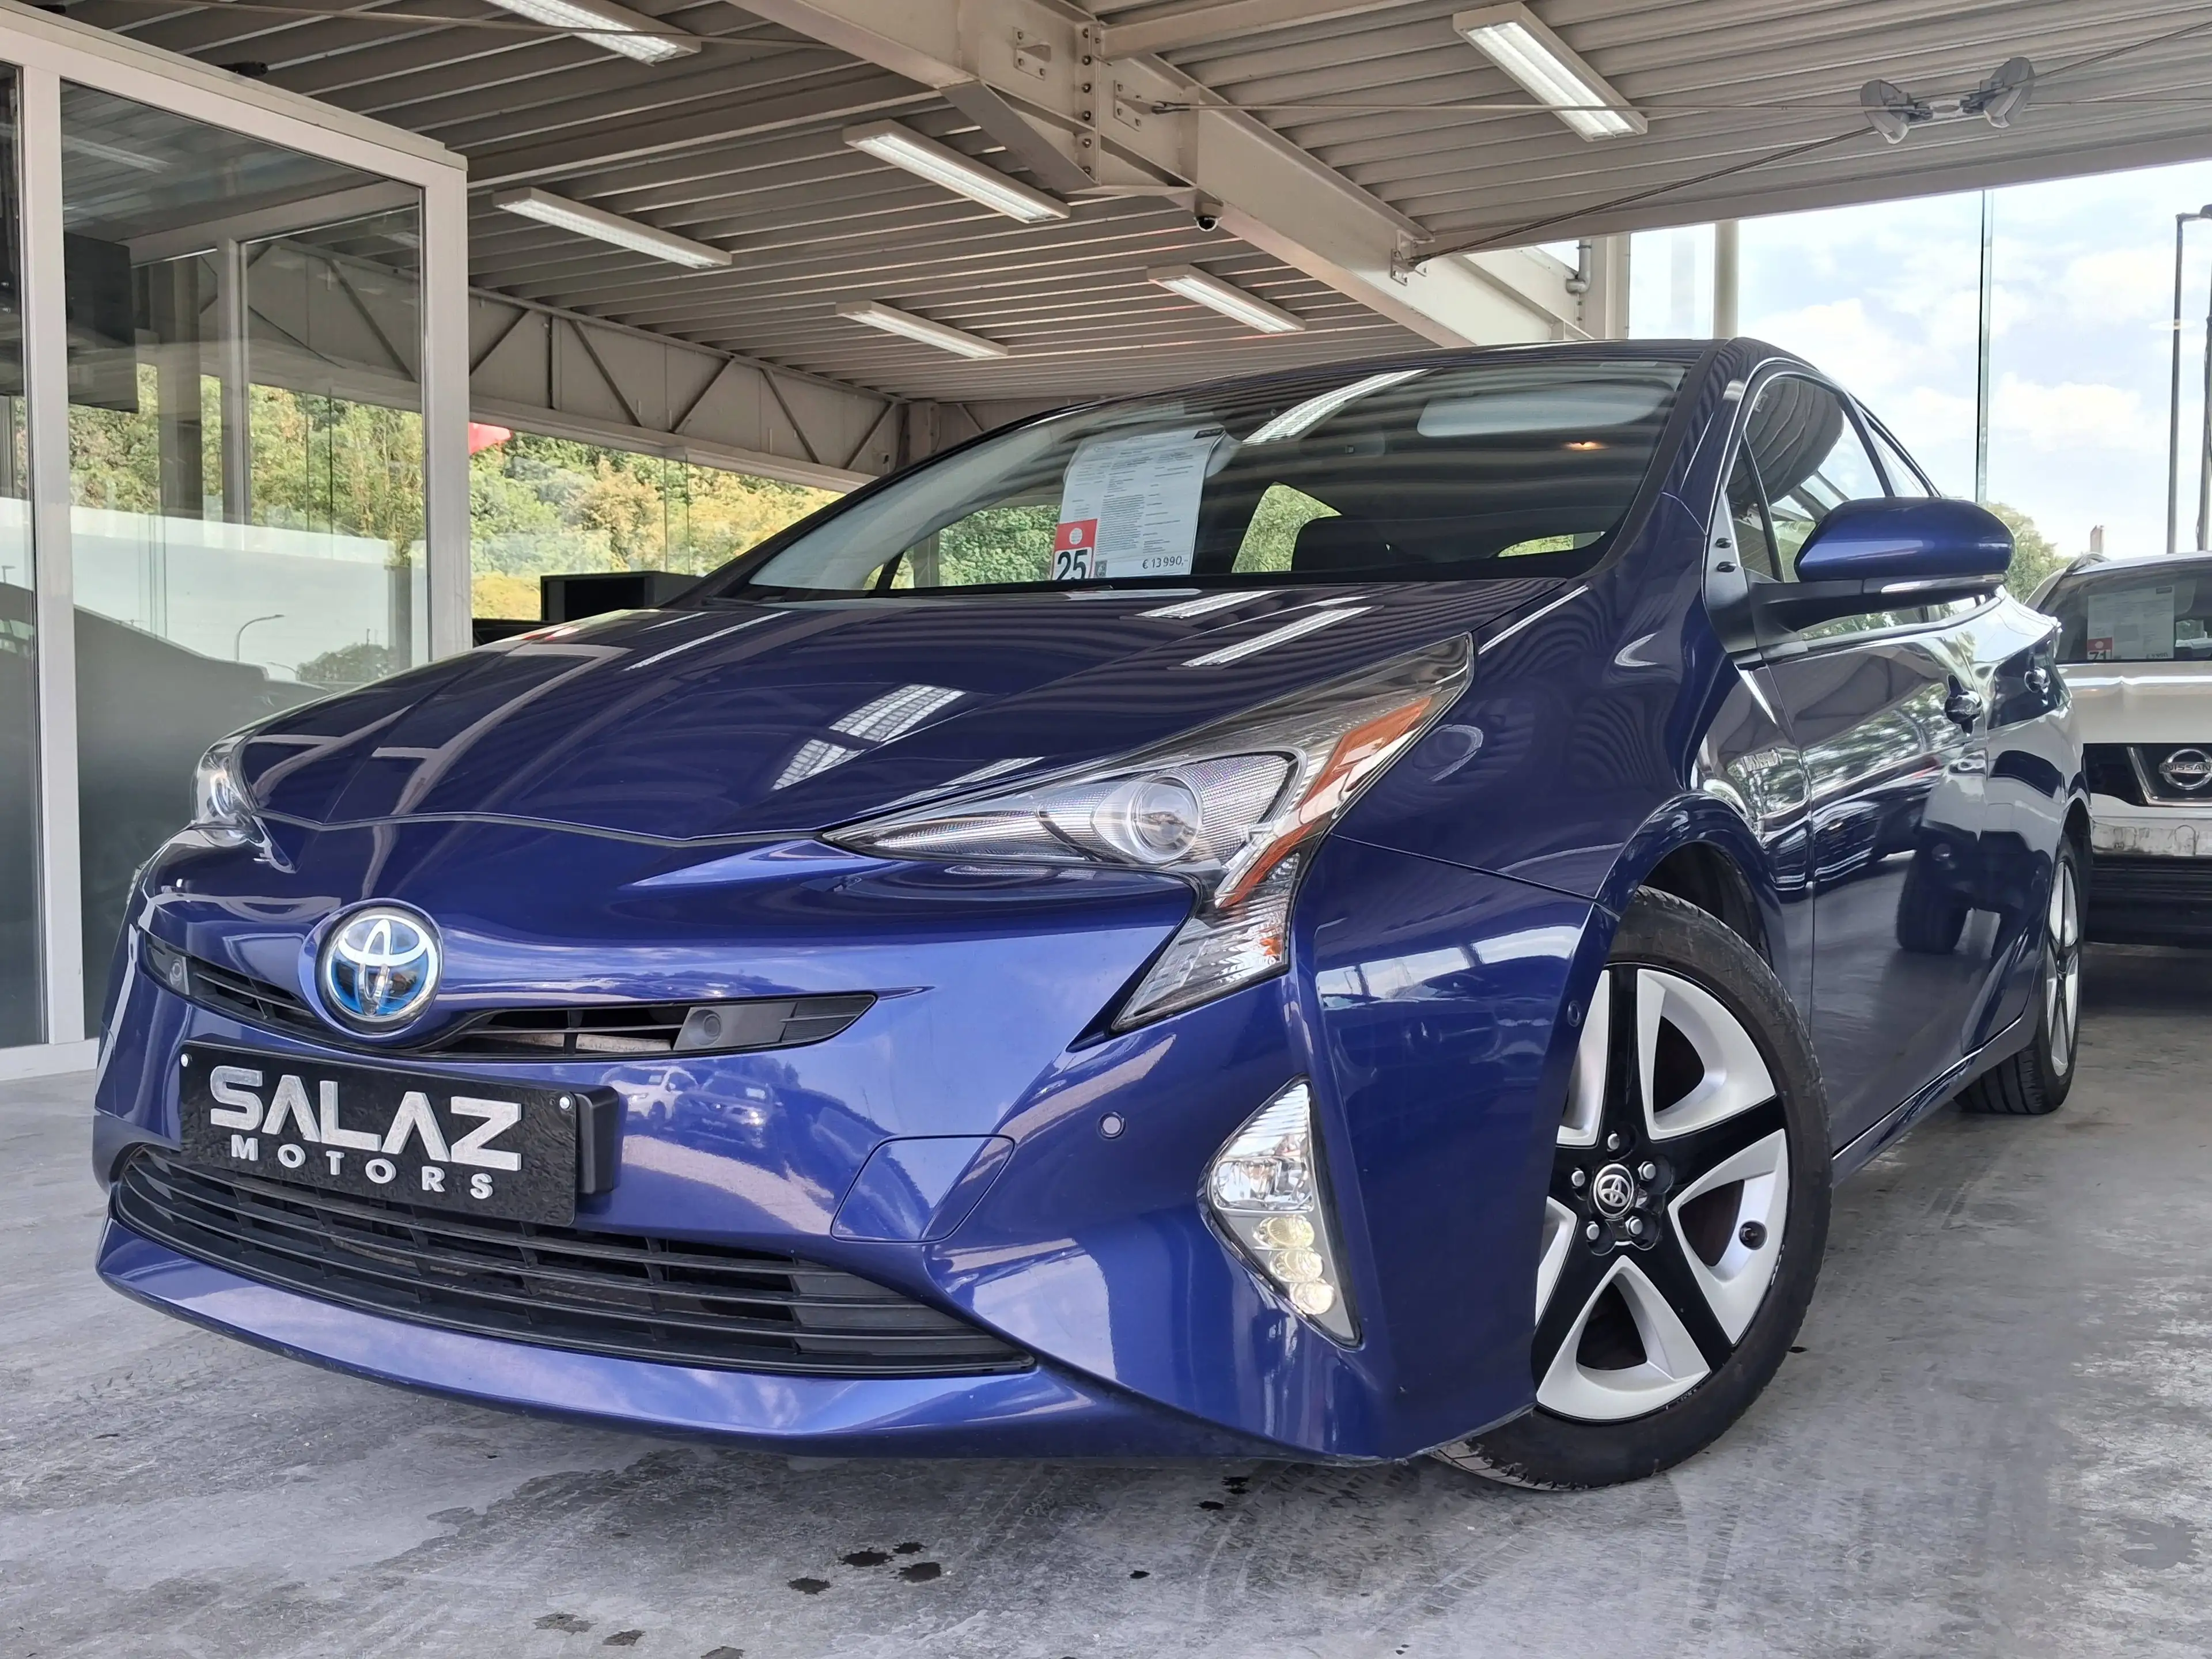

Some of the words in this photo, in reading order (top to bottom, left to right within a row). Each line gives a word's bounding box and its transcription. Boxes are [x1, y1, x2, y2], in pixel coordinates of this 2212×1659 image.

[1056, 549, 1088, 581] 25
[1142, 559, 1148, 569] €
[210, 1065, 521, 1172] SALAZ
[231, 1134, 494, 1200] MOTORS
